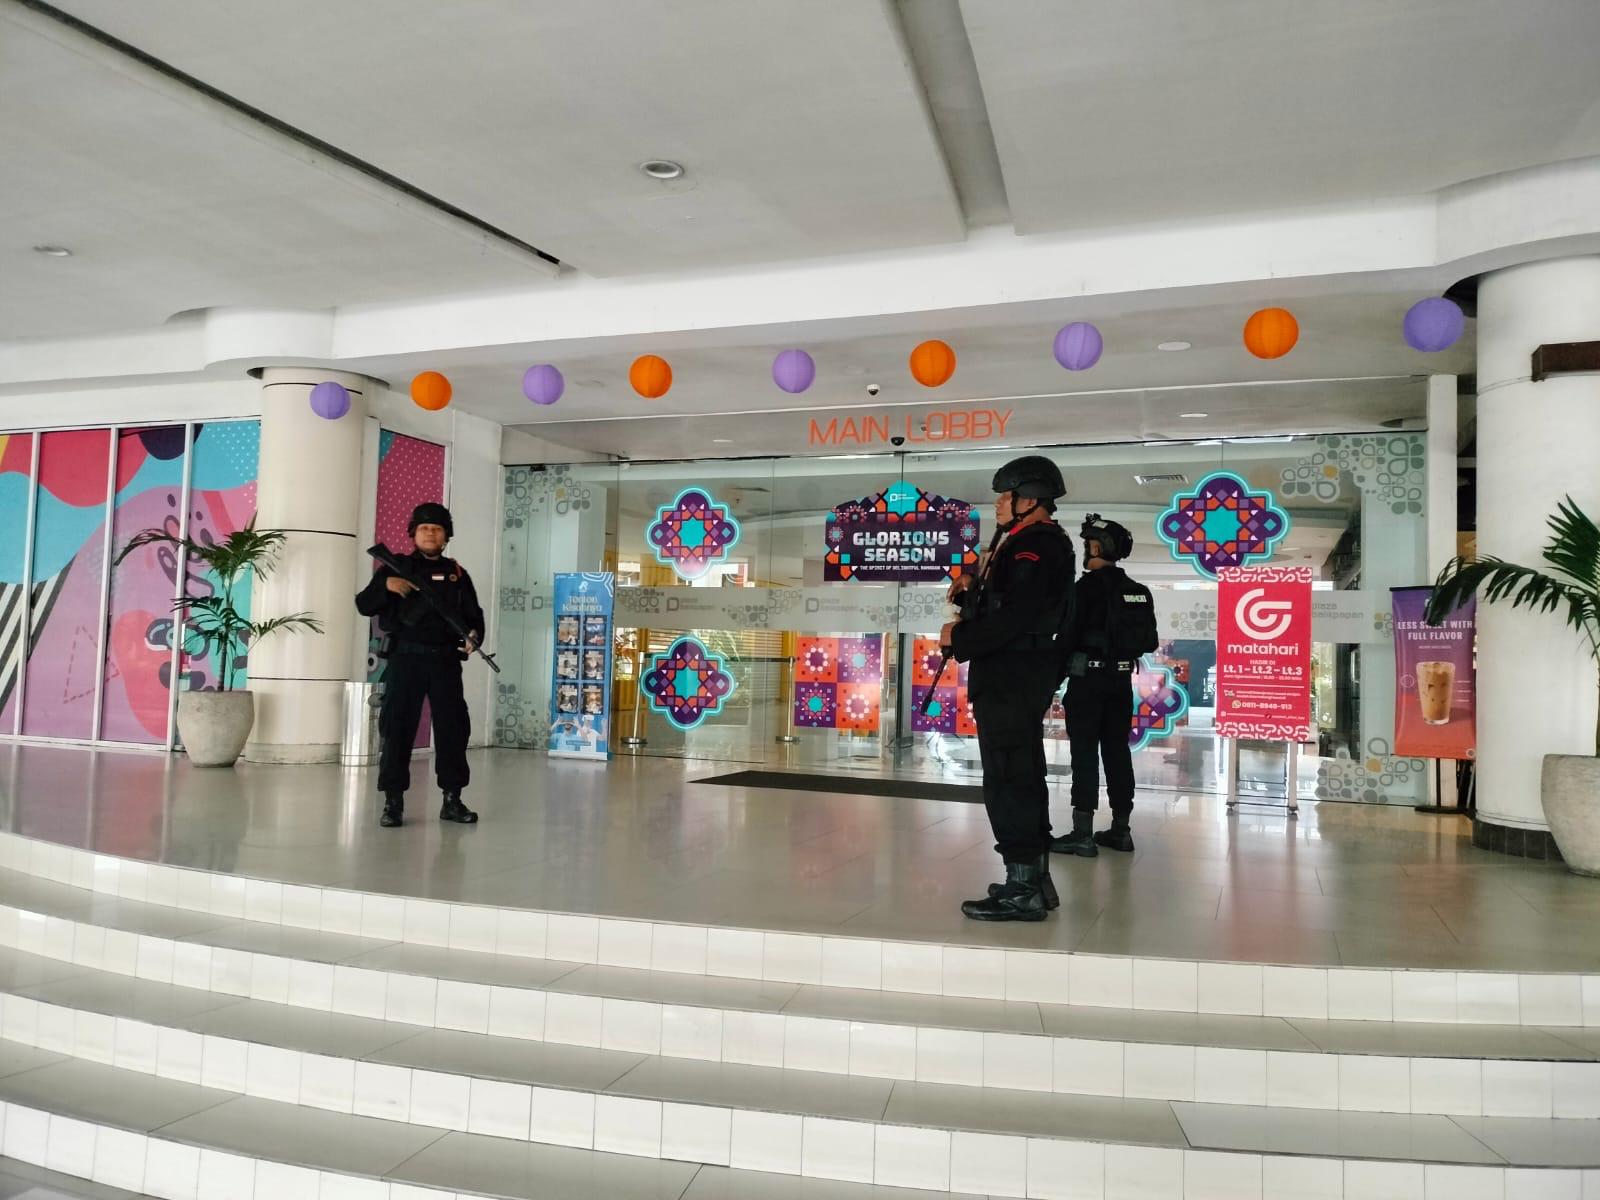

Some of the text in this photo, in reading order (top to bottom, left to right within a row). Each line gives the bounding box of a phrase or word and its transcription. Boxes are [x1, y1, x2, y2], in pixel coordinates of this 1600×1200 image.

[808, 409, 1013, 445] MAIN LOBBY
[852, 531, 950, 547] GLORIOUS
[864, 547, 937, 563] SEASON
[1397, 621, 1417, 630] LESS
[1450, 620, 1473, 629] WITH
[1407, 631, 1463, 640] FULL FLAVOR
[1227, 643, 1299, 656] matahari
